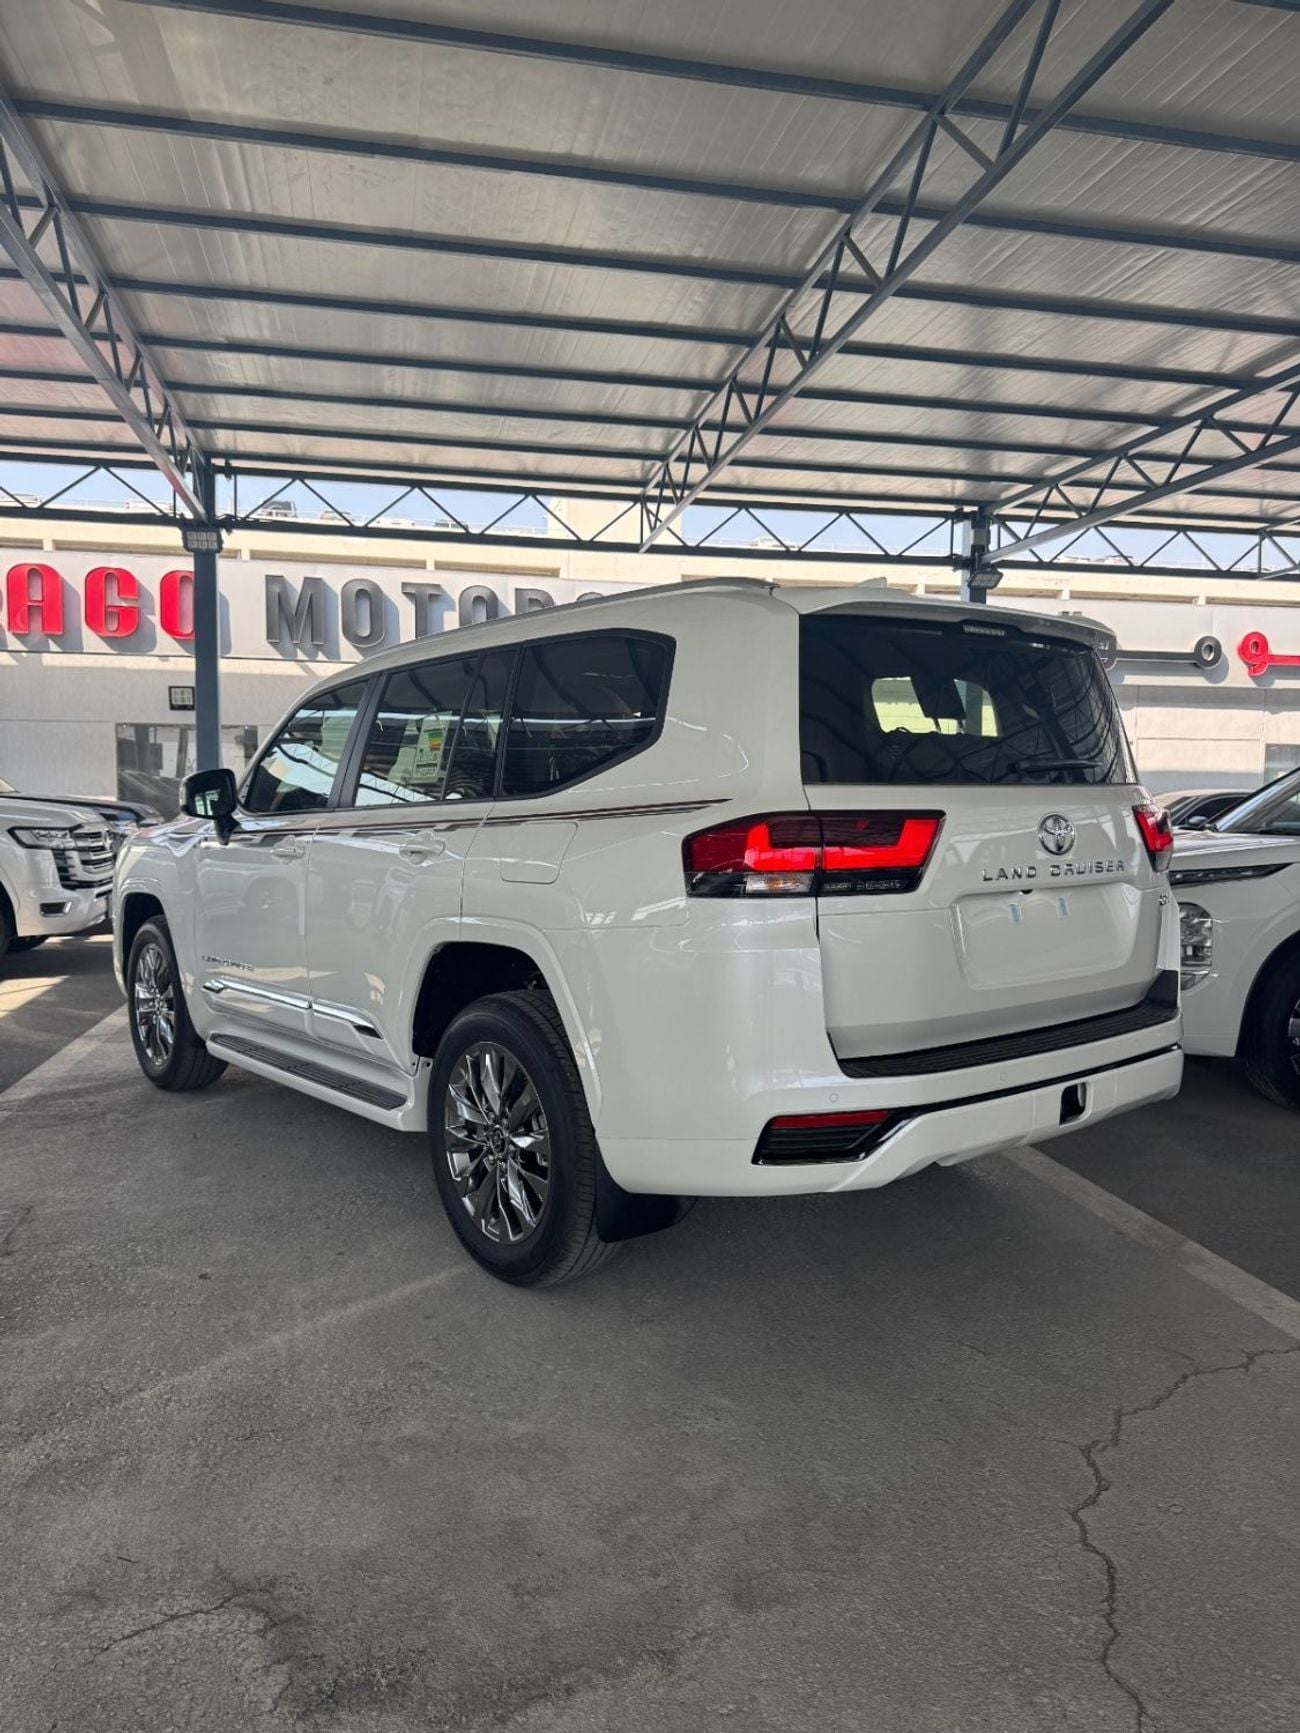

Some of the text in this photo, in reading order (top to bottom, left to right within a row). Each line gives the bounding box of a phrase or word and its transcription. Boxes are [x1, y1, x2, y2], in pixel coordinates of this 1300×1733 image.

[265, 575, 604, 648] MOTO
[982, 860, 1125, 881] LAND CRUISER
